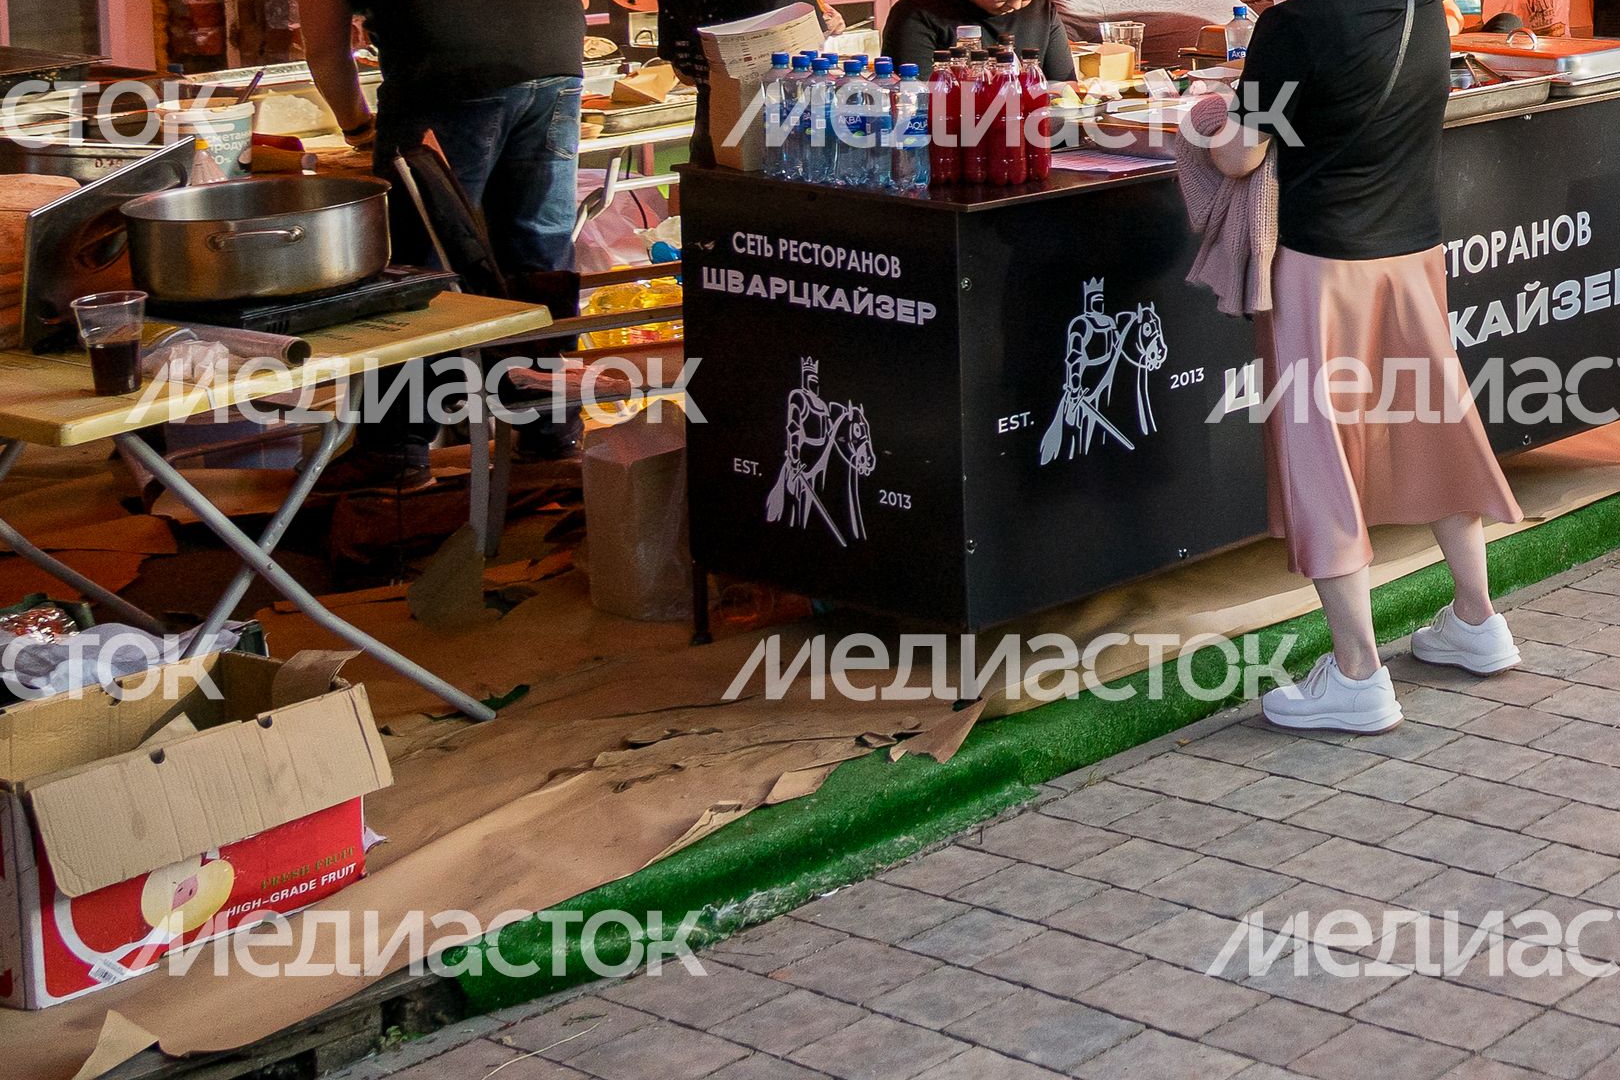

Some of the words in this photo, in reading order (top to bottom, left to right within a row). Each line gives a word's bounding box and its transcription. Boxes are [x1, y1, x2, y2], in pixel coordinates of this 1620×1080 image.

[732, 231, 774, 258] СЕТЬ
[779, 238, 902, 279] РЕСТОРАНОВ
[1443, 211, 1592, 278] ТОРАНОВ
[702, 266, 938, 326] ШВАРЦКАЙЗЕР
[998, 411, 1035, 434] EST.
[1169, 367, 1205, 389] 2013
[733, 457, 763, 477] EST.
[878, 489, 912, 510] 2013
[226, 879, 318, 918] HIGH-GRADE
[321, 862, 357, 887] FRUIT
[261, 864, 310, 890] FRESH
[315, 846, 354, 873] FRUIT
